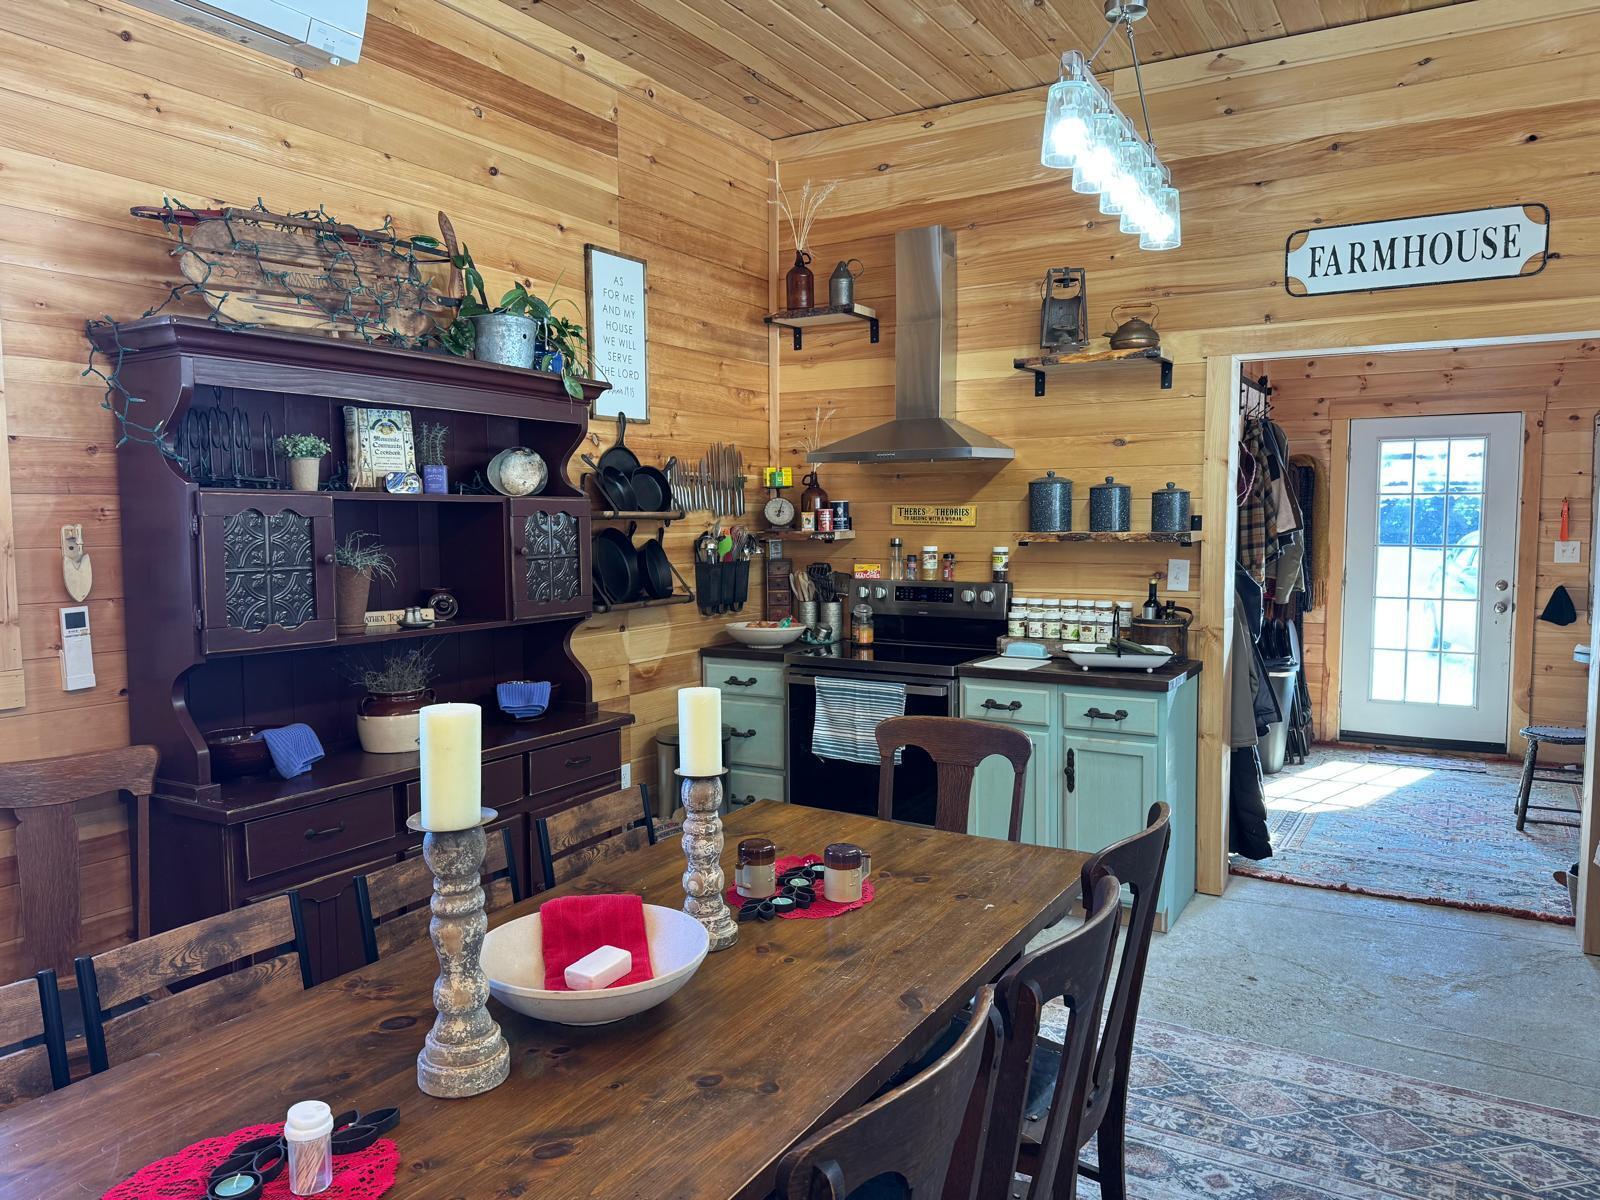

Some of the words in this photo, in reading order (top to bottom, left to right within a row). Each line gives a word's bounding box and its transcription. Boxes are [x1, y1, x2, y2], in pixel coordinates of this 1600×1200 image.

[1308, 223, 1521, 279] FARMHOUSE
[613, 276, 624, 287] AS
[603, 288, 620, 301] FOR
[622, 294, 635, 305] ME
[602, 304, 621, 316] AND
[623, 309, 636, 320] MY
[605, 321, 633, 335] HOUSE
[603, 335, 616, 347] WE
[618, 338, 637, 351] WILL
[607, 351, 633, 365] SERVE
[600, 365, 615, 377] THE
[617, 368, 640, 380] LORD
[935, 508, 970, 516] THEORIES
[364, 615, 386, 623] ATHER
